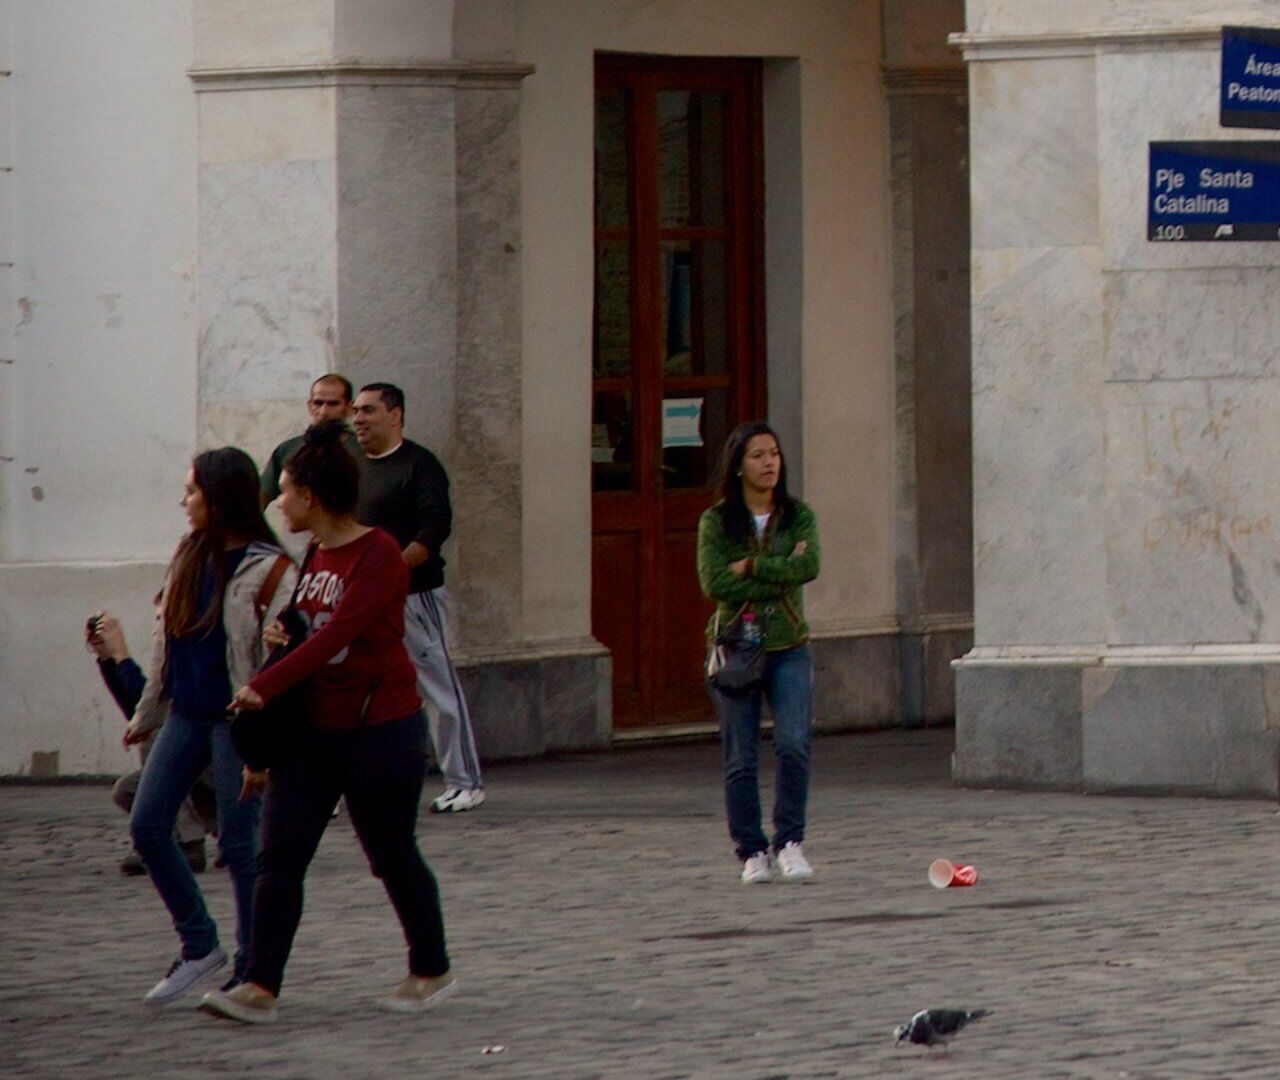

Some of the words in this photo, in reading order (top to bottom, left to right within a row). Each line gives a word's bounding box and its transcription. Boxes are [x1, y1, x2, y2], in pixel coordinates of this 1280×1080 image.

[1155, 169, 1185, 192] Pje
[1199, 168, 1254, 188] Santa
[1154, 194, 1230, 214] Catalina
[1155, 225, 1185, 240] 100
